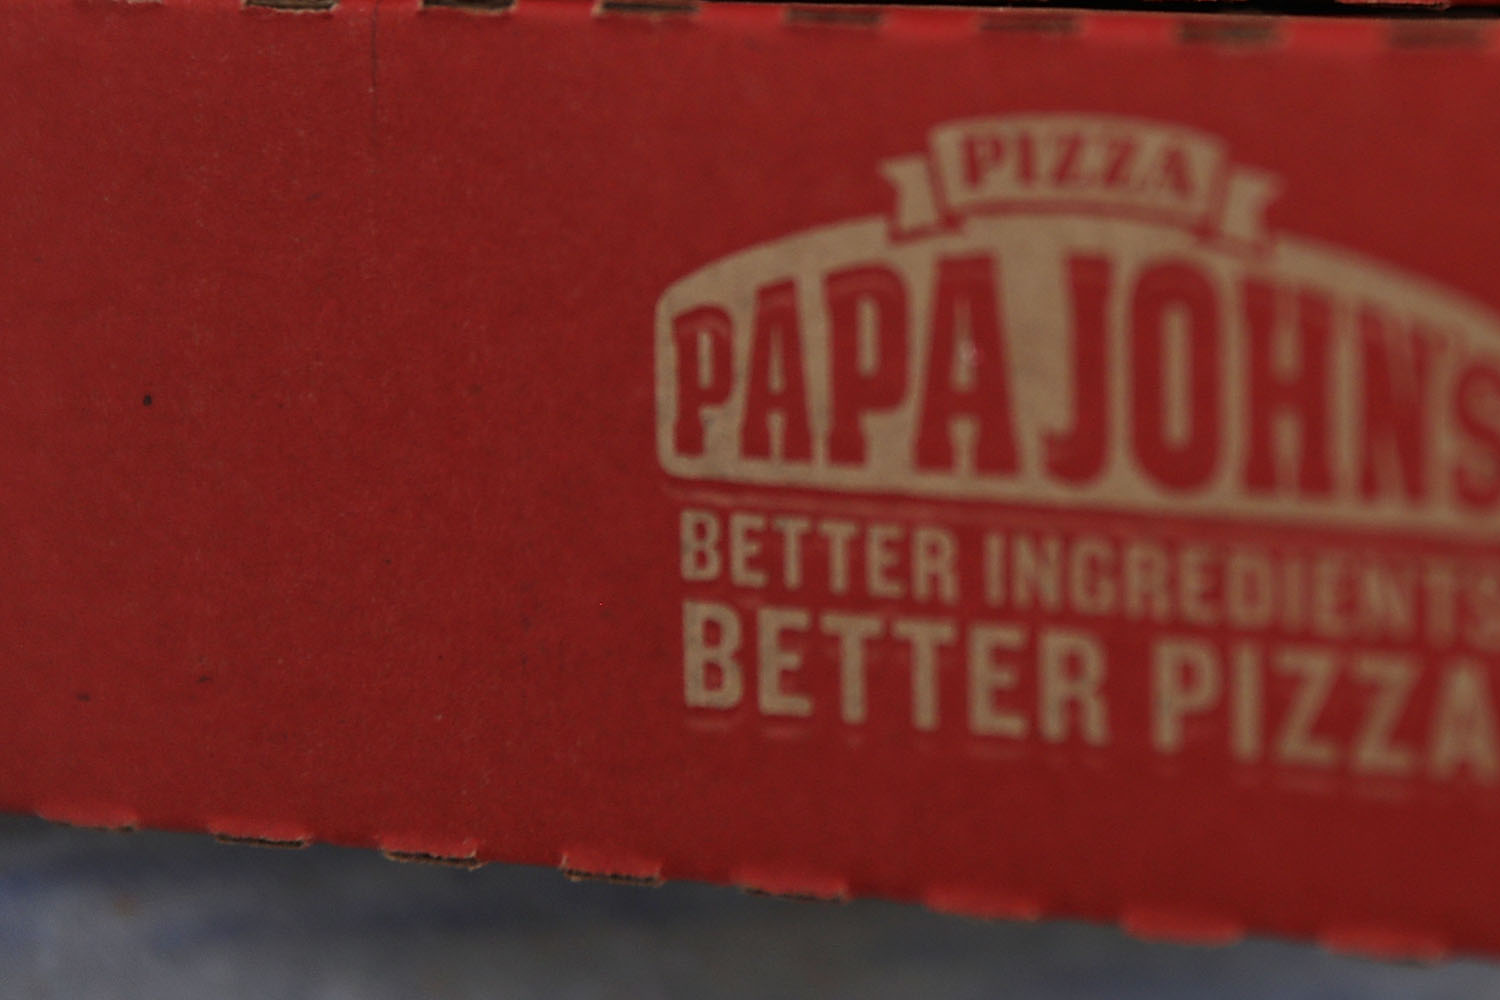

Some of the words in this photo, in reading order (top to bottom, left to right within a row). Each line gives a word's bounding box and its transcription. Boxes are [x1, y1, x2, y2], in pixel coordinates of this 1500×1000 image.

[960, 129, 1197, 200] PIZZA
[672, 253, 1020, 478] PAPA
[680, 507, 959, 603] BETTER
[682, 598, 1110, 746] BETTER
